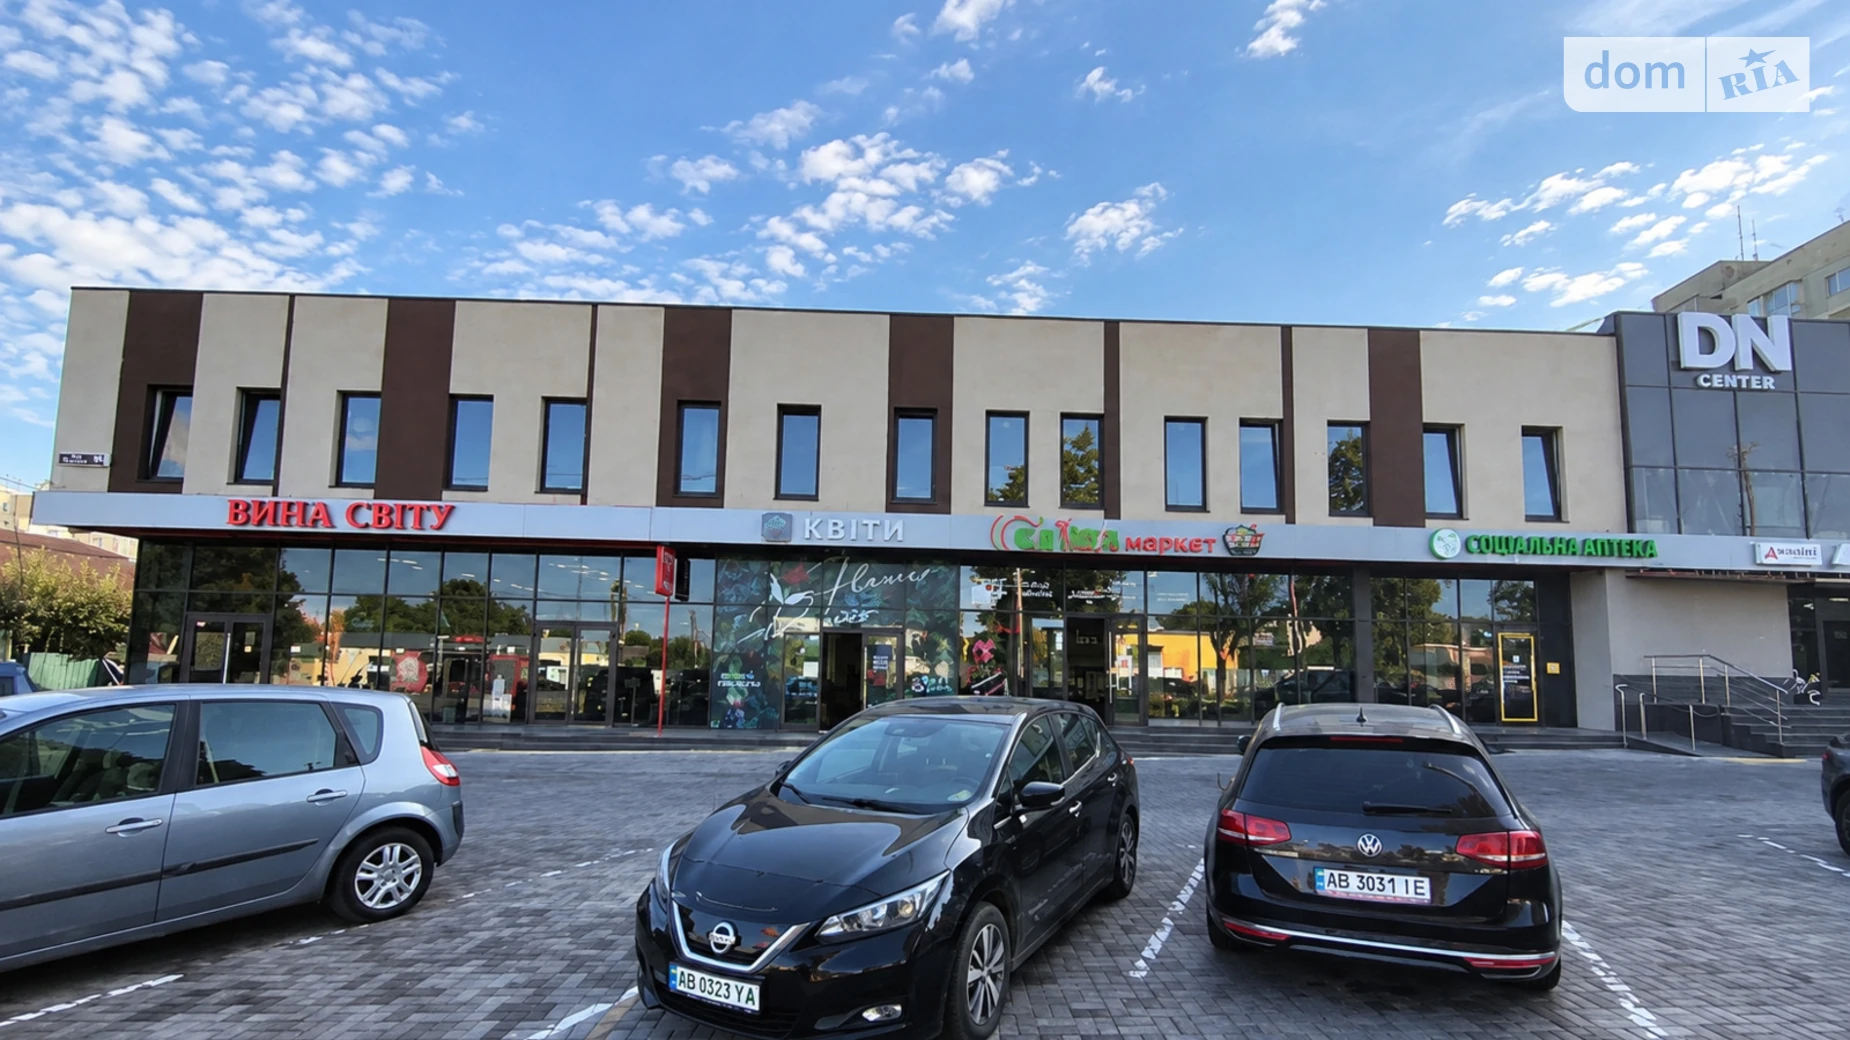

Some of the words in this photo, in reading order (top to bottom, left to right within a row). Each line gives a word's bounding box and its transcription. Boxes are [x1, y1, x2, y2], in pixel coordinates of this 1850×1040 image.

[1677, 312, 1793, 372] DN
[1698, 373, 1776, 390] CENTER
[226, 499, 335, 529] ВИНА
[345, 502, 456, 531] СВІТУ
[803, 518, 905, 543] КВІТИ
[1125, 535, 1217, 554] маркет
[1465, 534, 1579, 556] СОЦІАЛЬНА
[1583, 538, 1658, 558] АПТЕКА
[1327, 872, 1350, 889] AB
[1356, 875, 1396, 894] 3031
[1404, 879, 1426, 896] IE
[678, 971, 696, 990] AB
[699, 977, 731, 999] 0323
[735, 984, 756, 1006] YA
